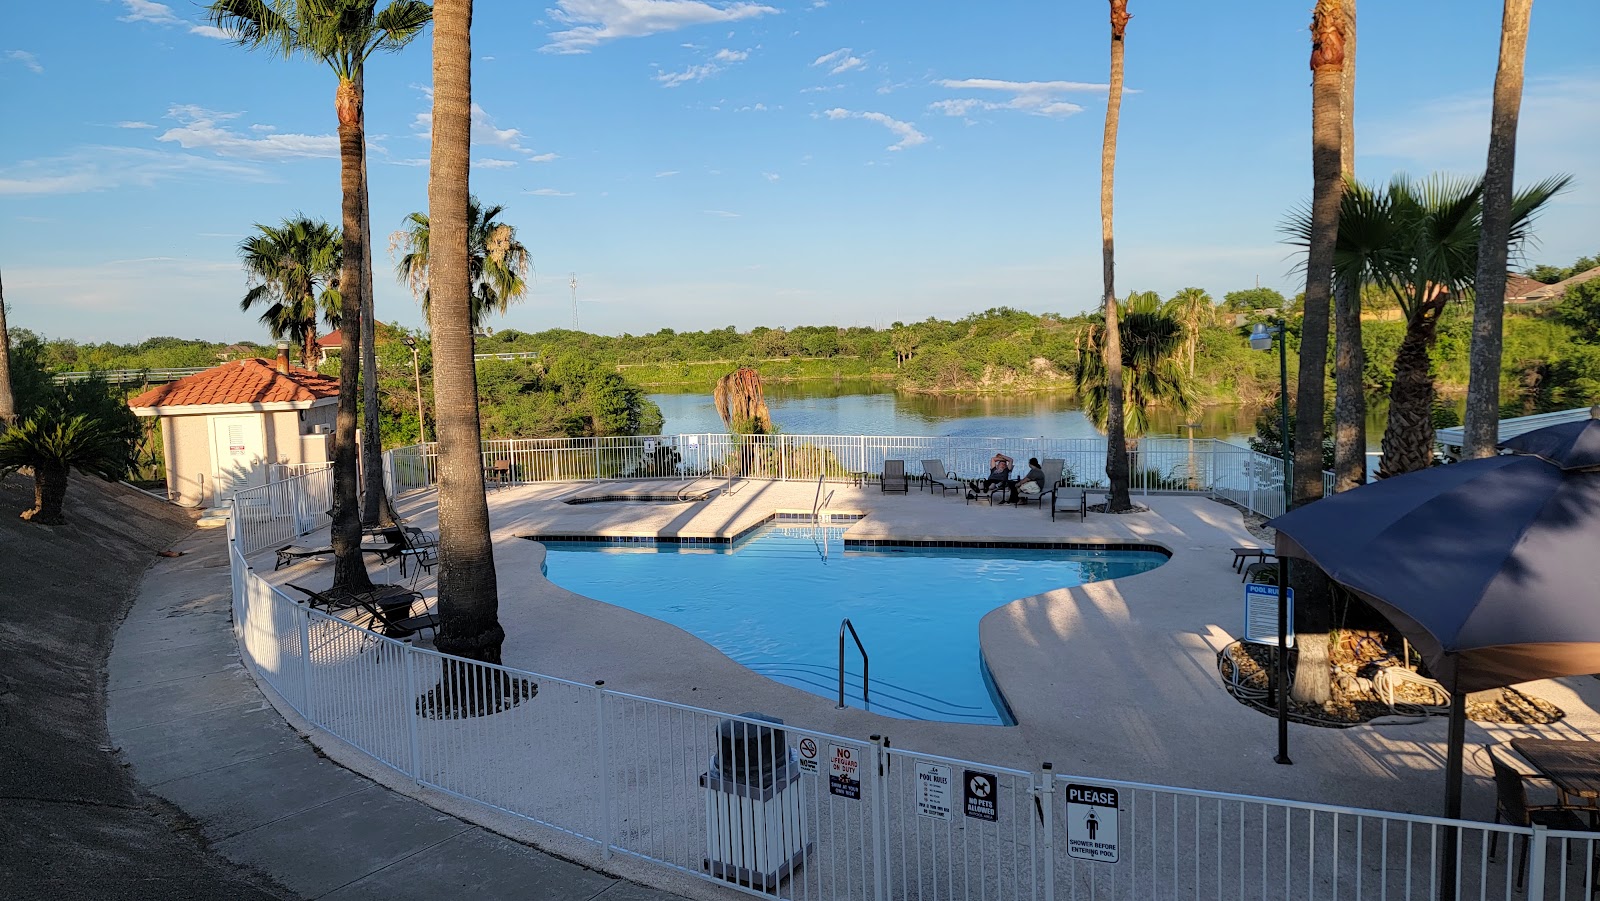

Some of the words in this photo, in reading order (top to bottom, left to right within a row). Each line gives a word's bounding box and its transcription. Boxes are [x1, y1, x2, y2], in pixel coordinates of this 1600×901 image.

[1250, 586, 1267, 594] POOL
[837, 748, 850, 759] NO
[800, 758, 807, 766] NO
[831, 757, 857, 767] LIFEGUARD
[842, 766, 855, 774] DUTY
[919, 772, 931, 781] POOL
[933, 775, 947, 784] RULES
[968, 796, 977, 805] NO
[978, 798, 992, 808] PETS
[1069, 789, 1115, 805] PLEASE
[968, 804, 994, 815] ALLOWED
[1069, 839, 1093, 848] SHOWER
[1094, 842, 1116, 850] BEFORE
[1071, 846, 1098, 855] ENTERING
